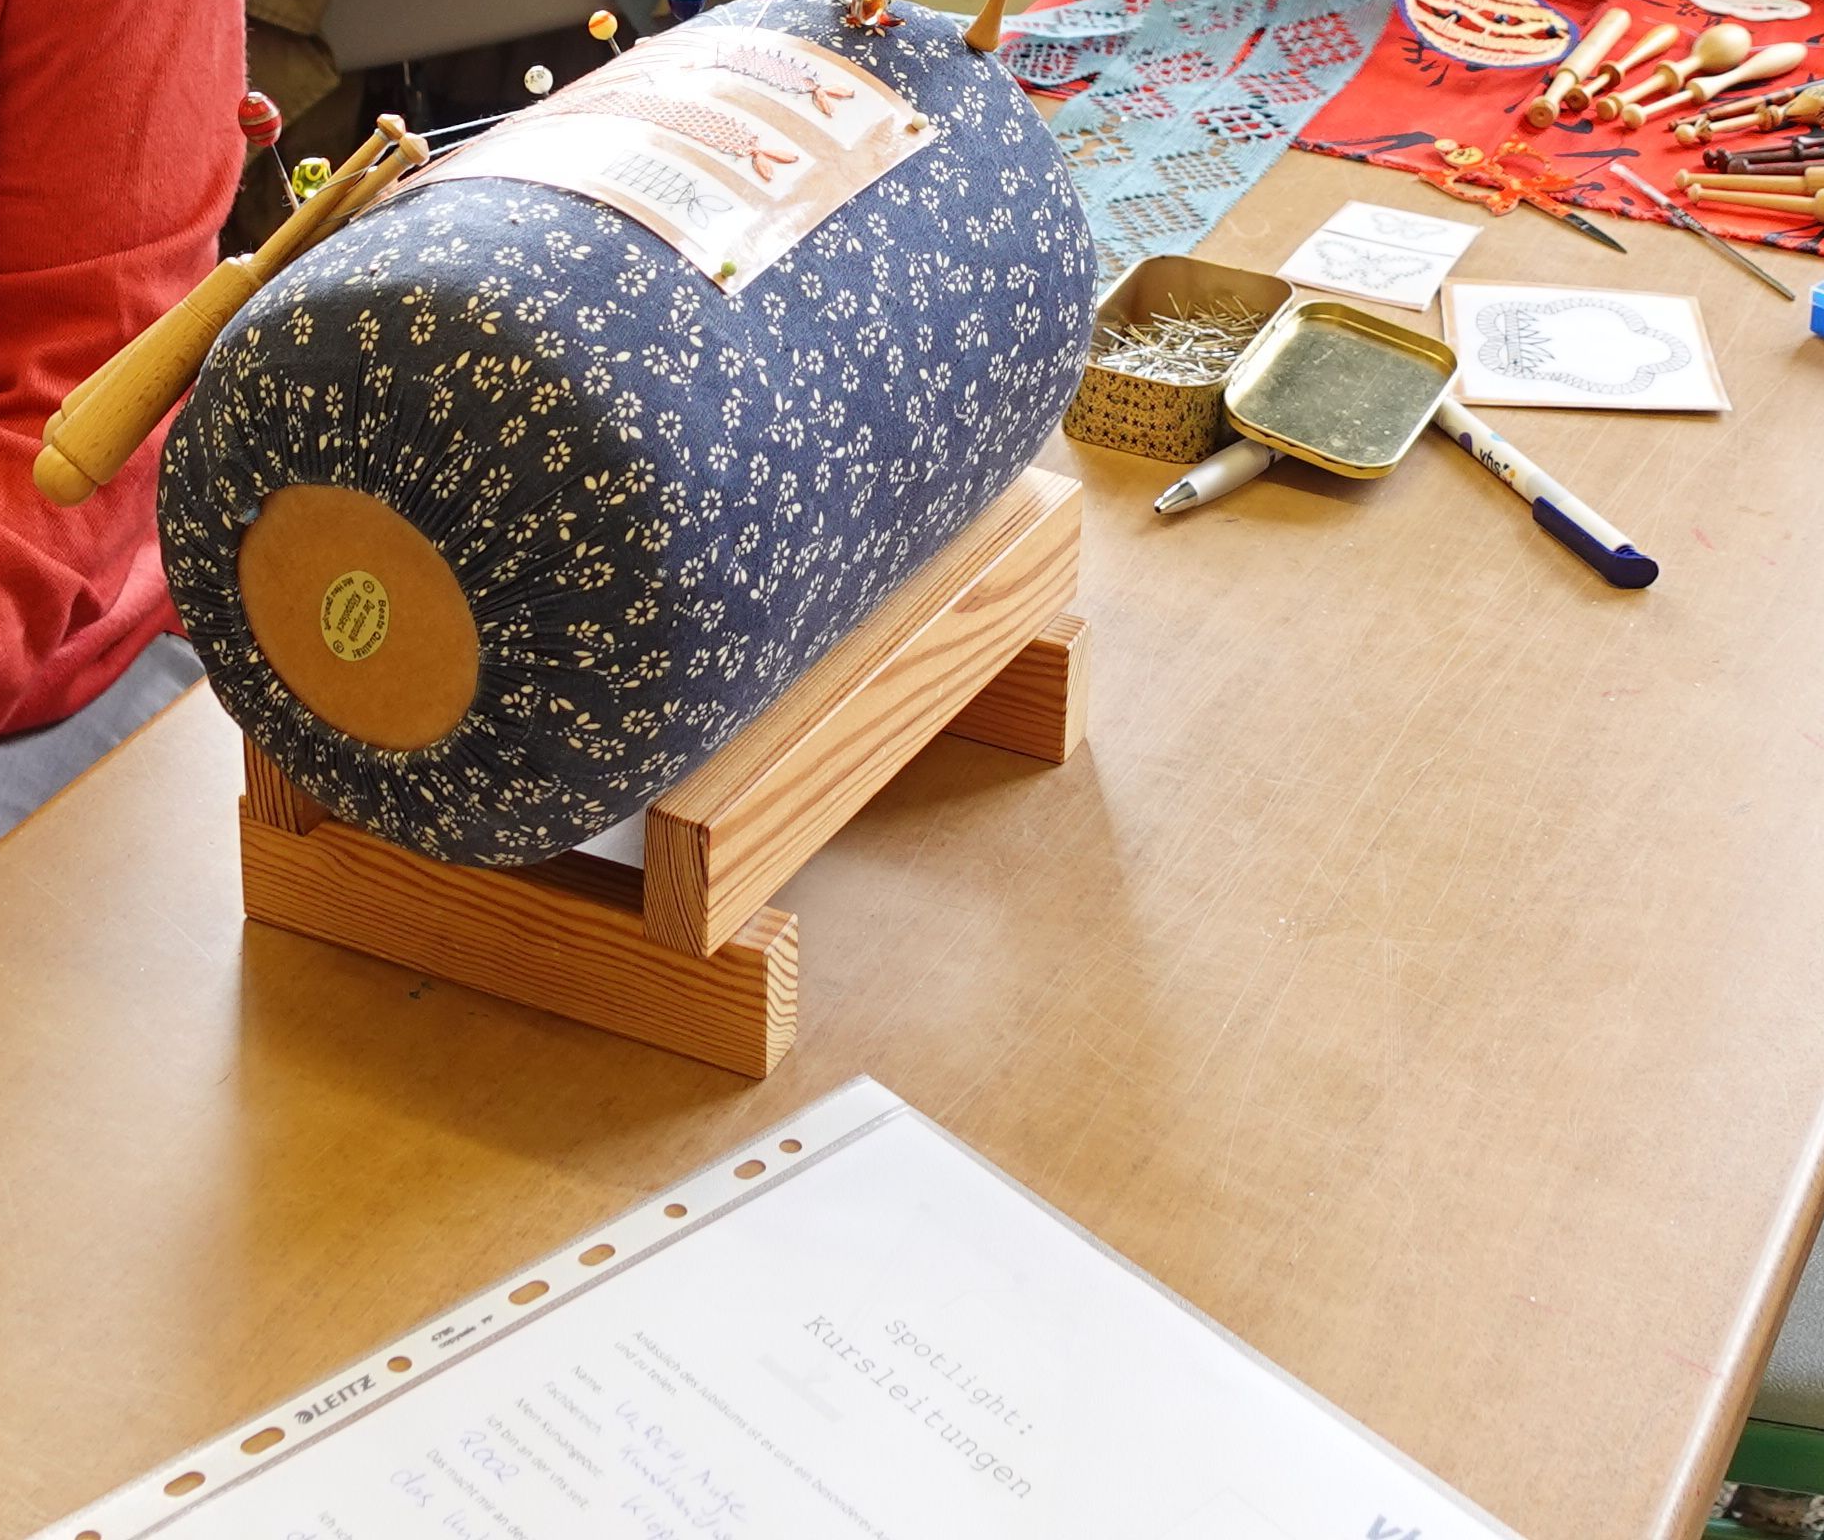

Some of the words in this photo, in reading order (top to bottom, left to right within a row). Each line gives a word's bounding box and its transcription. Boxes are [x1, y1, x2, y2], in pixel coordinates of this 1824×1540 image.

[377, 599, 387, 630] Beste
[311, 1373, 377, 1417] LEITZ
[803, 1315, 1032, 1499] Kursleitungen
[885, 1318, 1034, 1436] Spotlight:
